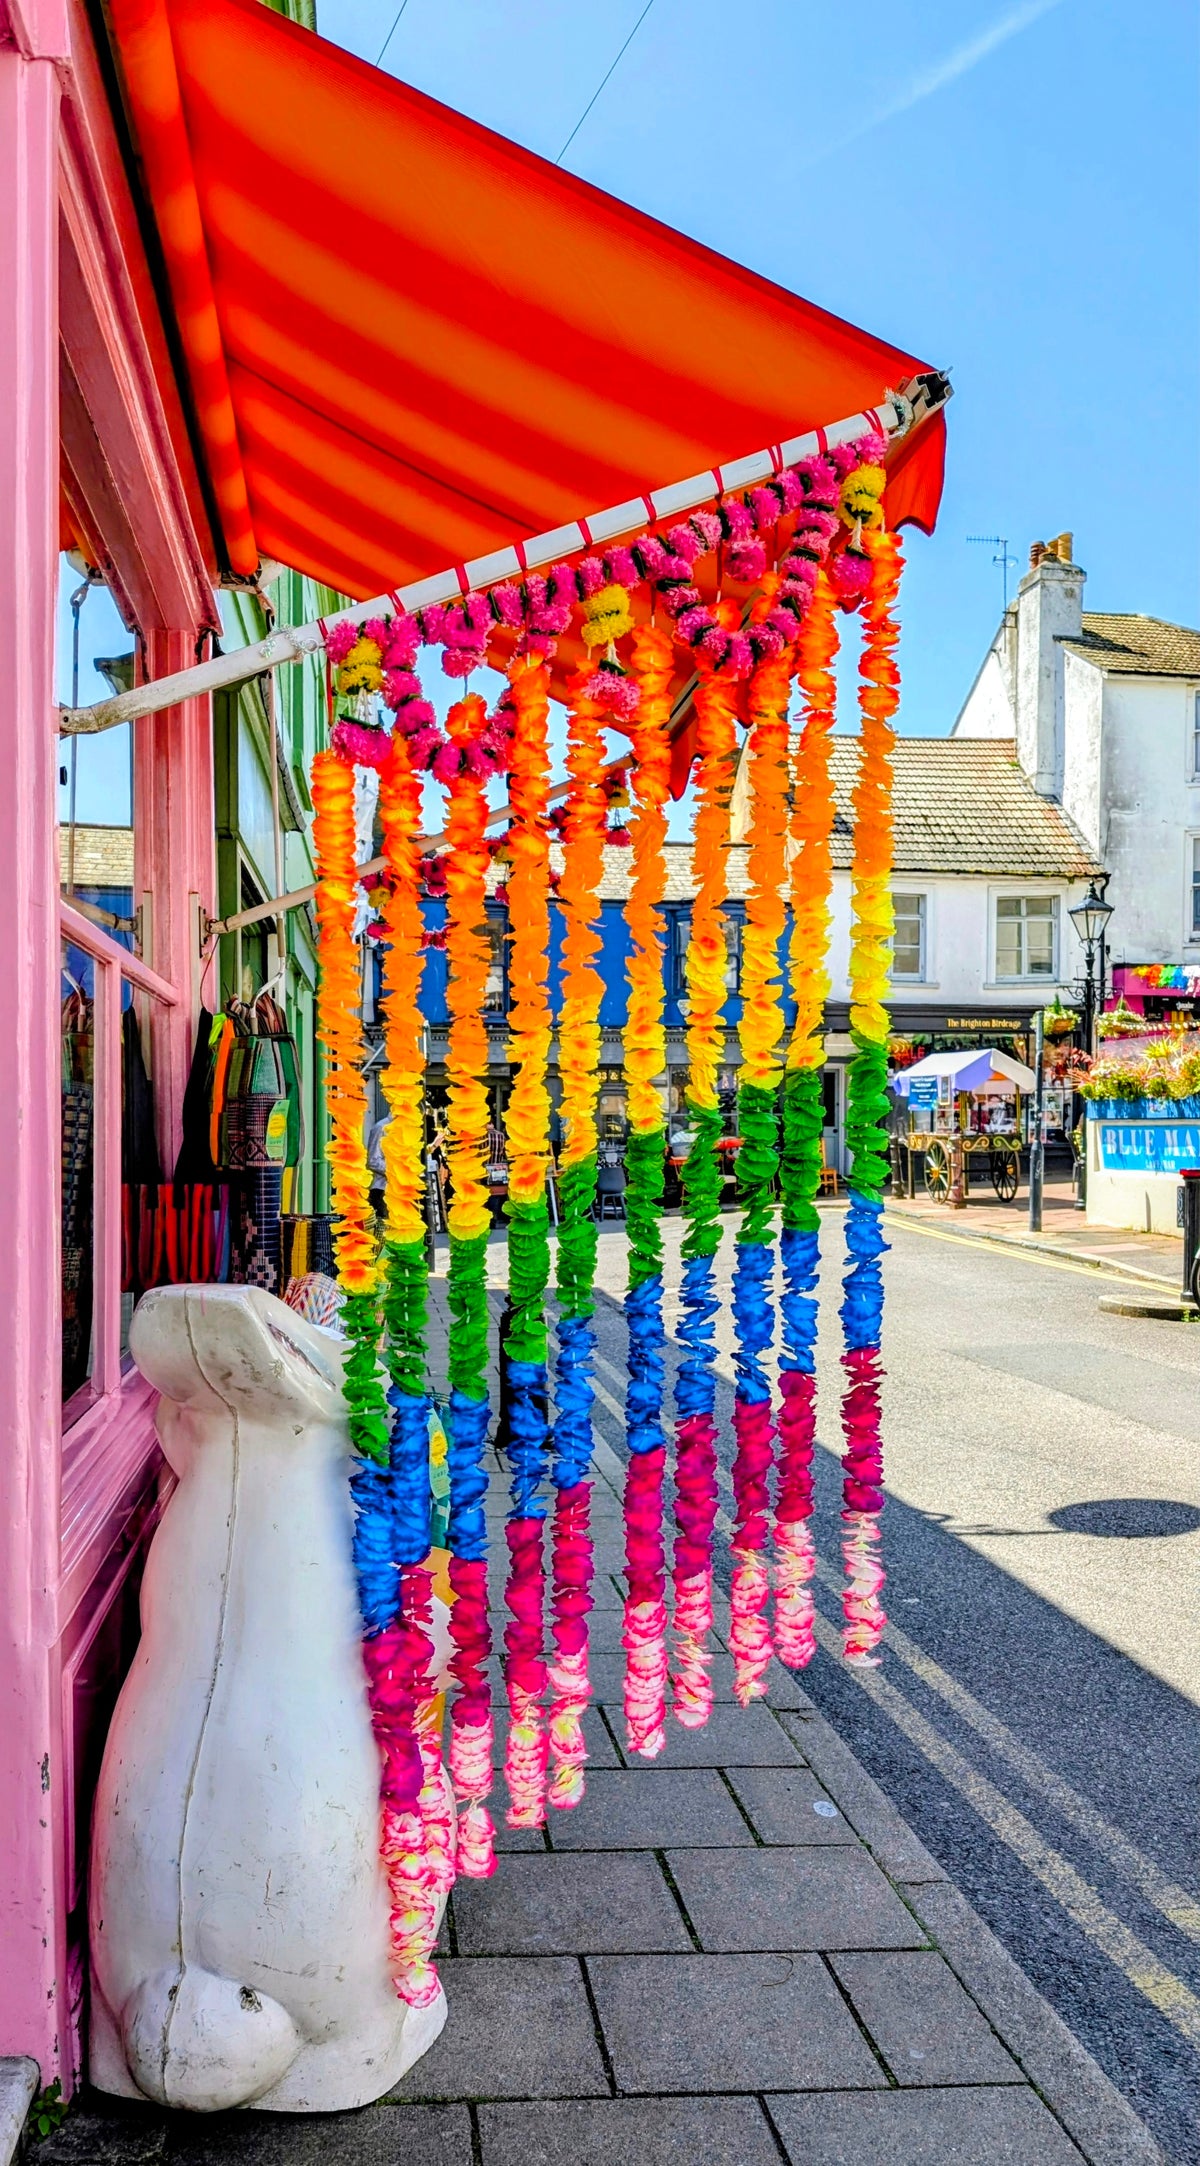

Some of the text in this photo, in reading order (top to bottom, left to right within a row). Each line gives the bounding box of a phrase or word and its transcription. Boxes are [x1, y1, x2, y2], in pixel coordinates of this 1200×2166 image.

[947, 1018, 1021, 1030] The Brighton Birdcage
[610, 1071, 618, 1081] &
[1105, 1129, 1200, 1158] BLUE MA
